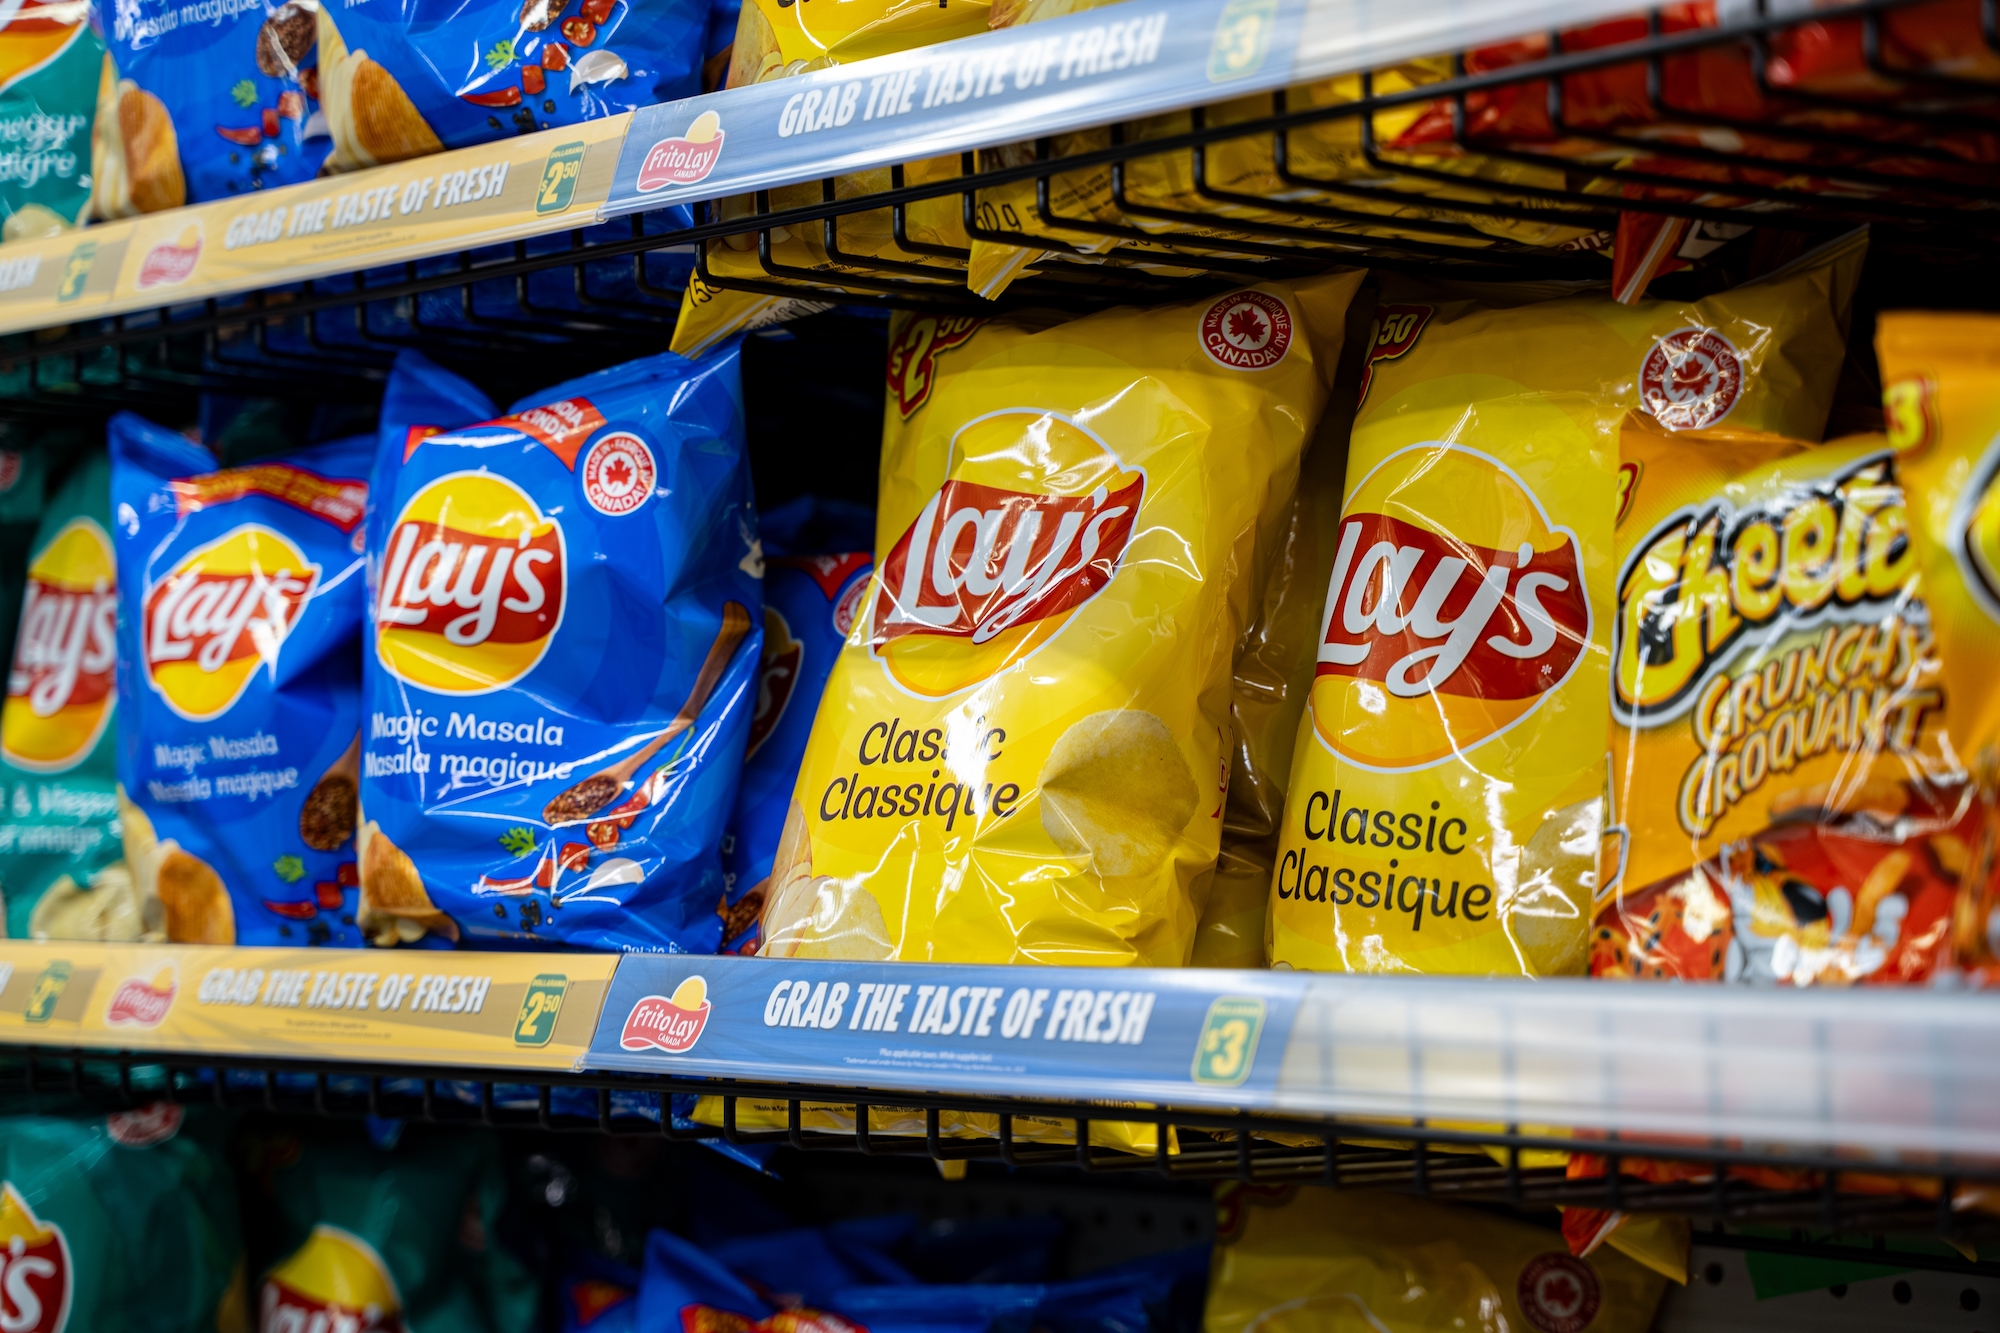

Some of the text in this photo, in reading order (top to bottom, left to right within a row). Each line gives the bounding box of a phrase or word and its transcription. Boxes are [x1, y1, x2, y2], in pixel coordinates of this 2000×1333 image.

[777, 86, 860, 138] GRAB
[862, 75, 920, 120] THE
[922, 47, 1020, 110] TASTE
[1014, 40, 1066, 91] OF
[1058, 13, 1168, 82] FRESH
[224, 206, 288, 249] GRAB
[287, 195, 330, 239] THE
[330, 183, 401, 230] TASTE
[400, 176, 436, 216] OF
[433, 160, 511, 210] FRESH
[673, 169, 697, 178] CANADA
[1206, 293, 1291, 348] MADE IN FABRIQUÉ AU
[378, 523, 554, 646] Lay's
[884, 485, 1129, 645] Lay's
[150, 567, 306, 674] Lay's
[1316, 521, 1570, 697] Lay's
[371, 709, 564, 746] Magic Masala
[858, 718, 1007, 766] Clasc
[365, 745, 574, 787] Masala magique
[819, 770, 1021, 832] Classique
[1303, 788, 1468, 856] Classic
[1278, 848, 1493, 931] Classique
[199, 968, 492, 1014] GRAB THE TASTE OF FRESH
[763, 980, 1157, 1045] GRAB THE TASTE OF FRESH
[657, 1032, 681, 1047] CANADA
[1203, 1019, 1250, 1077] $3
